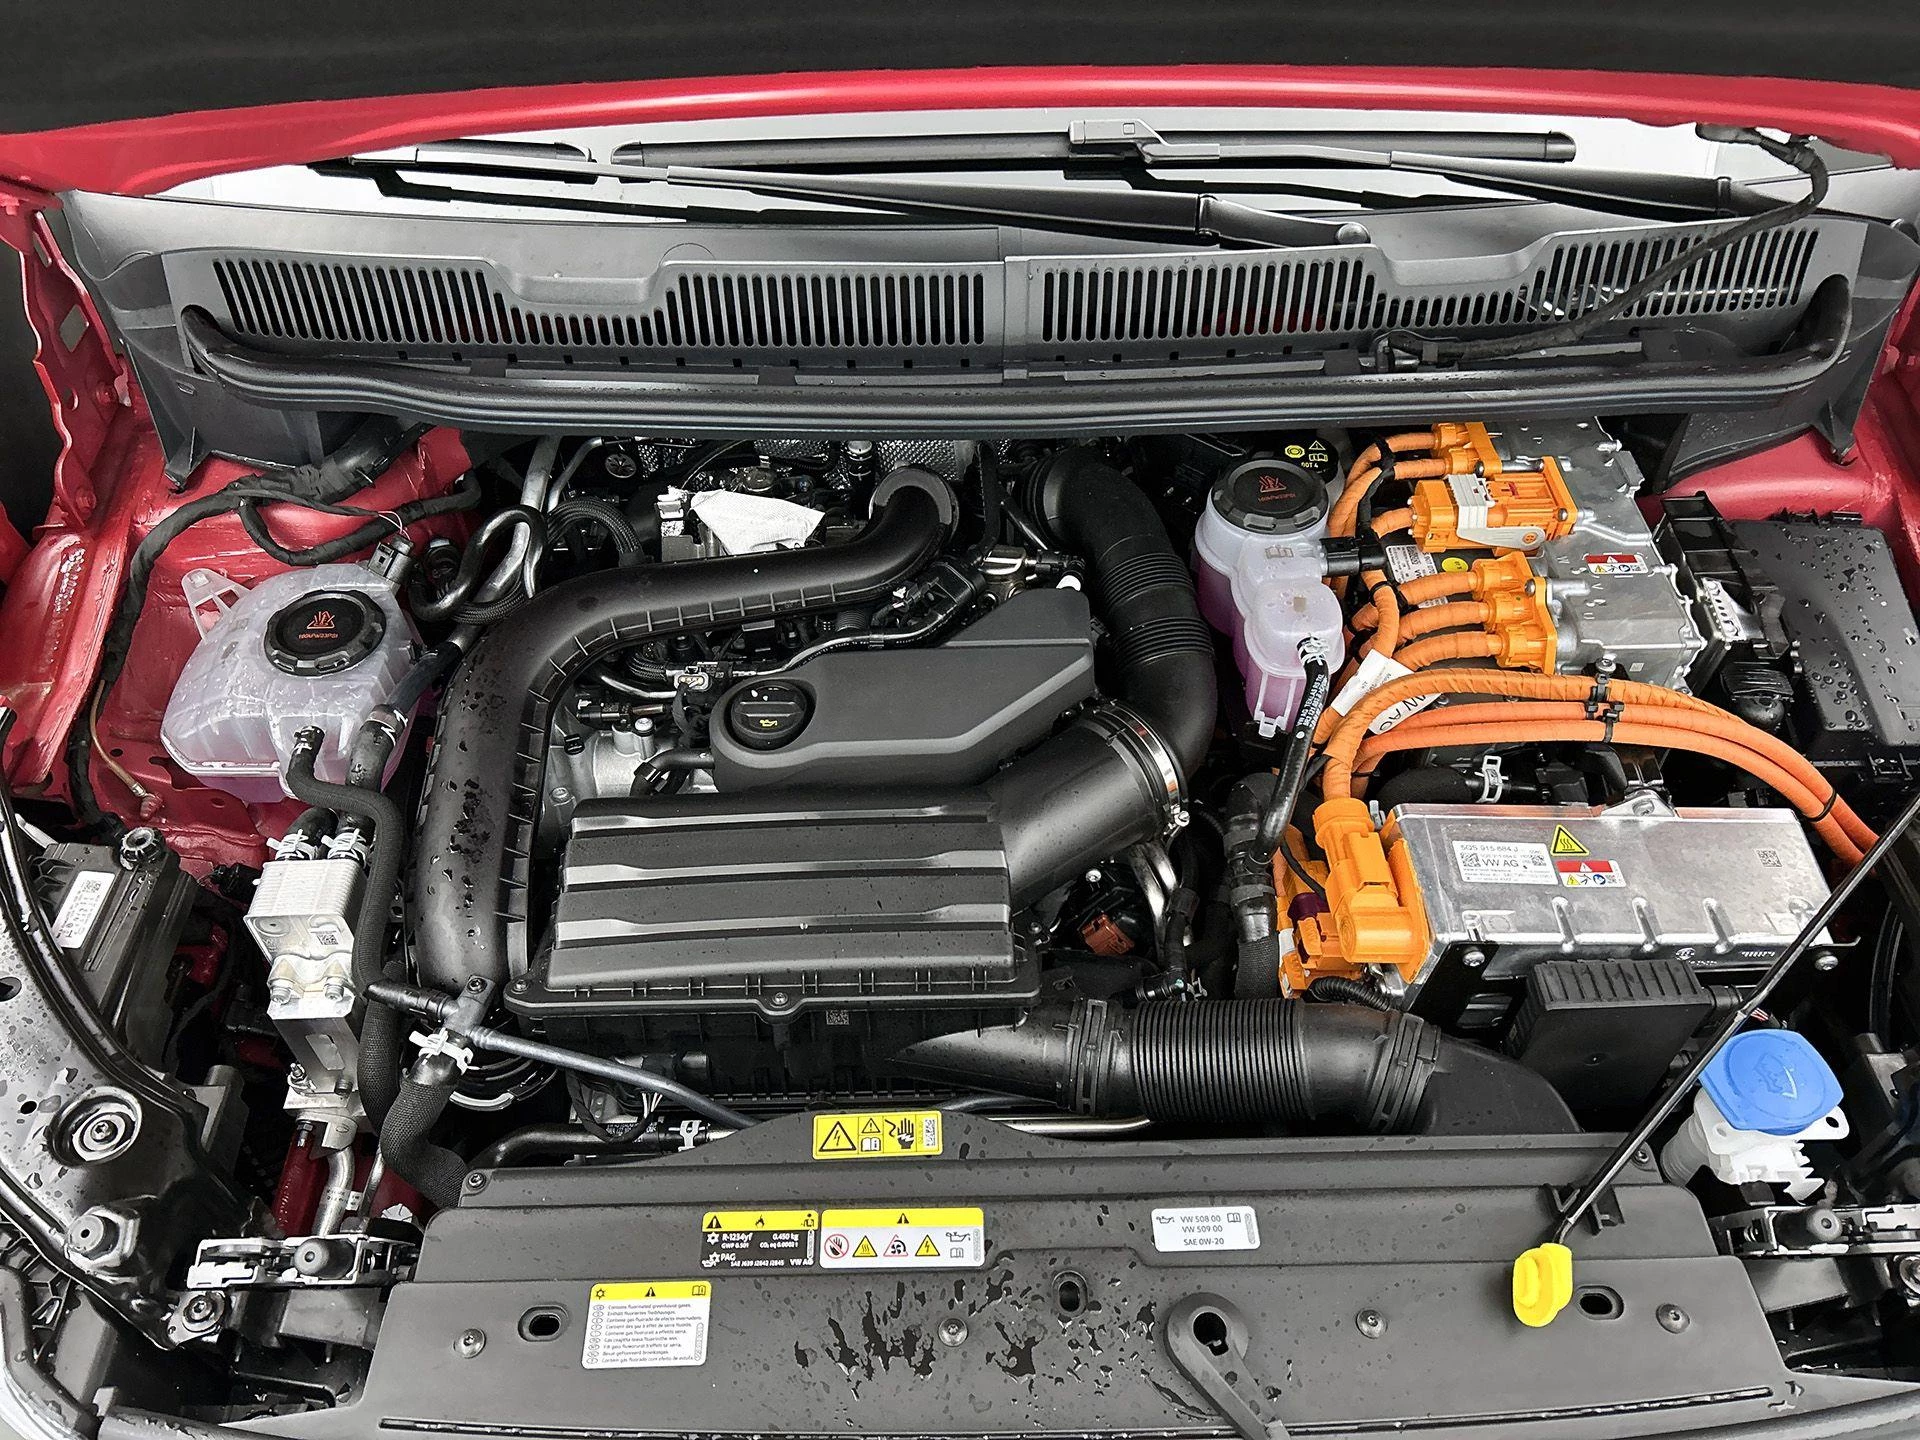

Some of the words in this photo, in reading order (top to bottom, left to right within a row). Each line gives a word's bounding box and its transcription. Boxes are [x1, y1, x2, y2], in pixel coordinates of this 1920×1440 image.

[1482, 858, 1499, 866] VW
[1503, 859, 1519, 867] AG
[1180, 1215, 1194, 1223] VW
[1210, 1214, 1221, 1222] 00
[1196, 1225, 1211, 1233] 509
[722, 1232, 754, 1243] R-1234yf
[1183, 1238, 1198, 1246] SAE
[1199, 1237, 1225, 1246] 0W-20
[720, 1252, 736, 1261] PAG
[790, 1258, 802, 1266] VW
